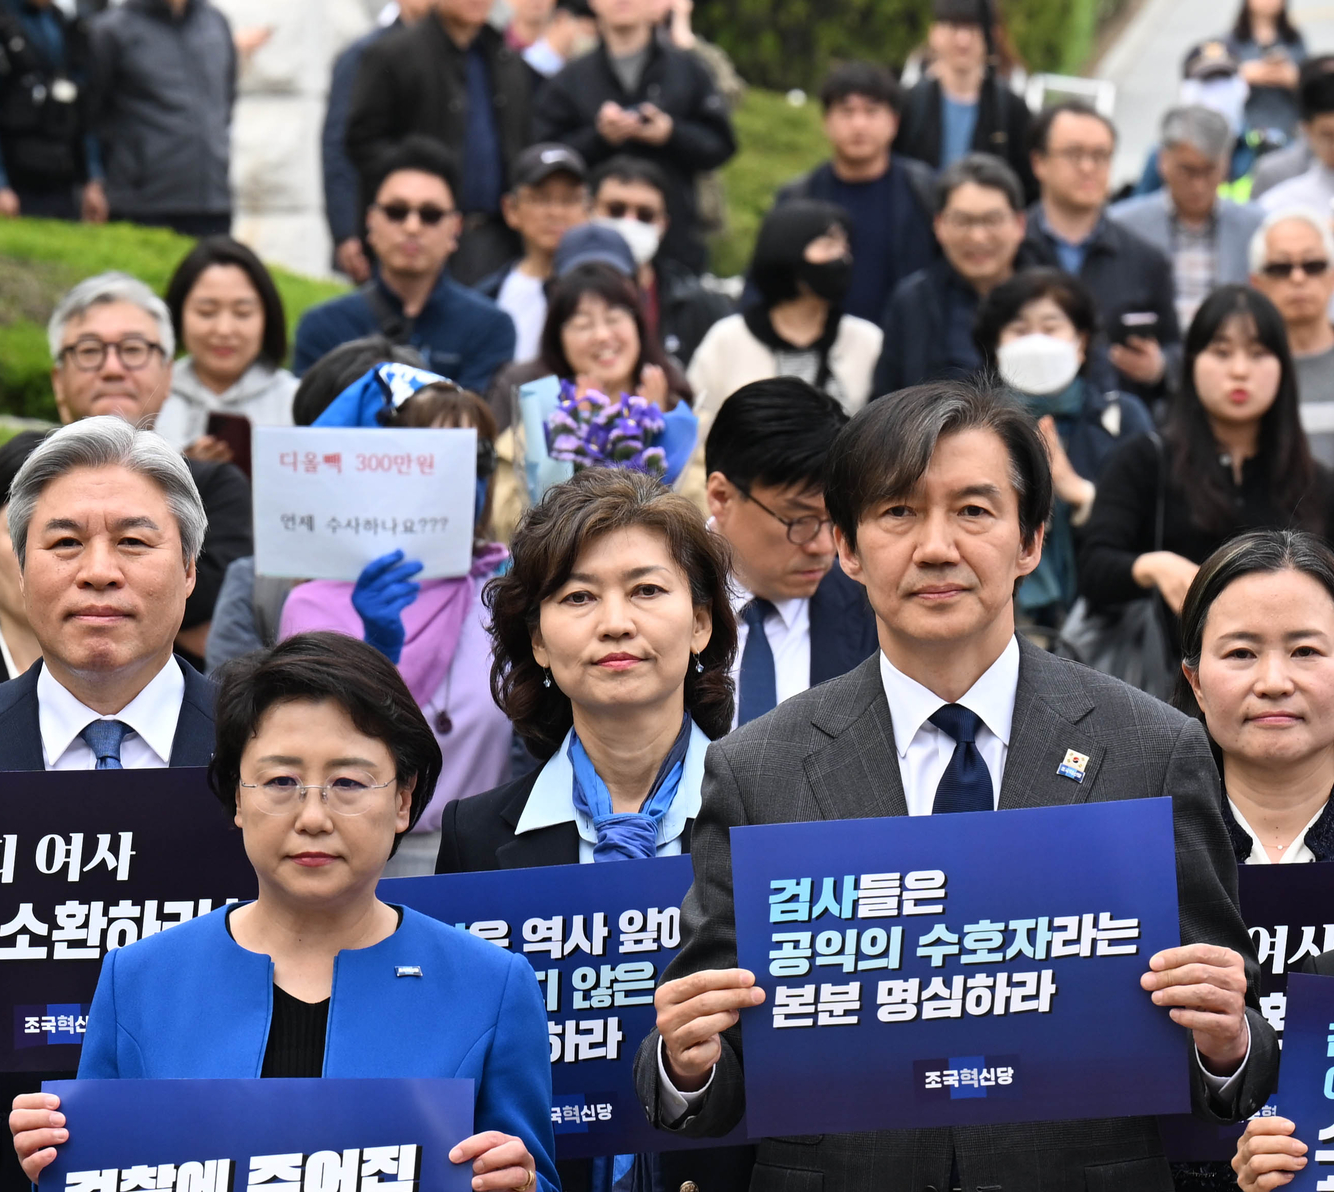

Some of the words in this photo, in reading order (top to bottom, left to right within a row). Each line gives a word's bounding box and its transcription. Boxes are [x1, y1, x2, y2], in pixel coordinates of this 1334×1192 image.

[356, 452, 435, 476] 300만원
[280, 513, 316, 533] 언제
[325, 515, 450, 536] 수사하나요???
[36, 832, 136, 881] 여사
[769, 869, 947, 923] 검사들은
[522, 912, 609, 960] 역사
[769, 925, 903, 977] 공익의
[915, 911, 1139, 968] 수호자라는
[572, 961, 656, 1010] 않은
[773, 982, 860, 1027] 본분
[876, 969, 1056, 1022] 명심하라
[548, 1017, 622, 1062] 하라
[926, 1067, 1013, 1088] 조국혁신당
[551, 1104, 612, 1123] 국혁신당
